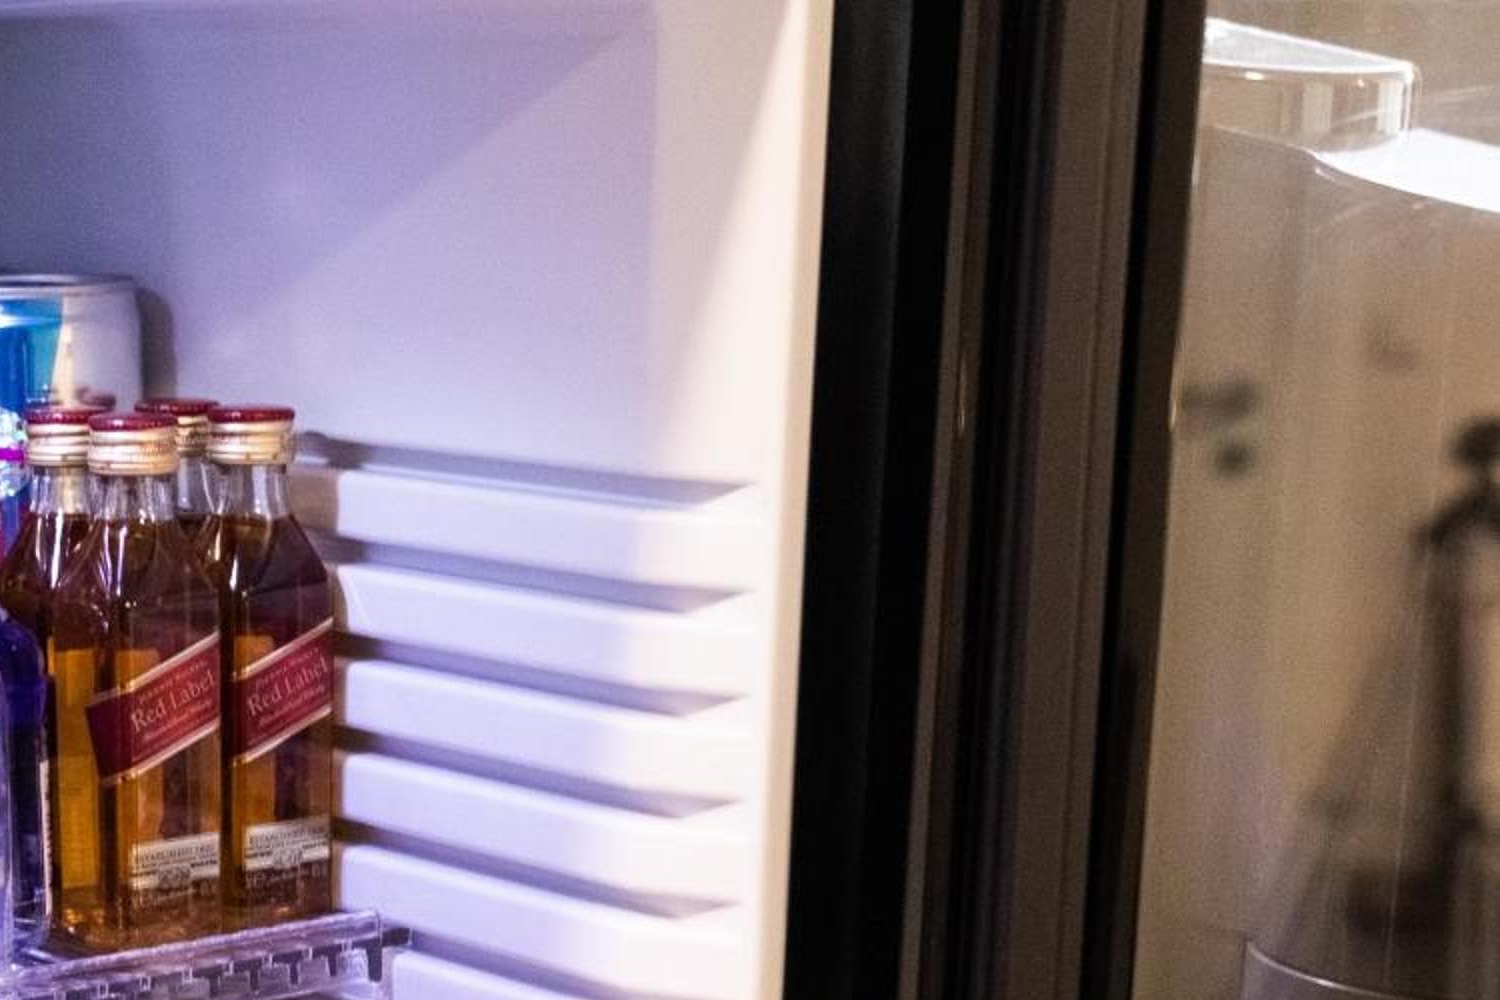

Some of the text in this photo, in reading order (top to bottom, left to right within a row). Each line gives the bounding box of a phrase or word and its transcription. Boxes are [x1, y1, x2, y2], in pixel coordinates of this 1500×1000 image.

[131, 702, 167, 732] Red
[169, 670, 216, 709] Label
[249, 683, 282, 716] Red
[285, 656, 328, 694] Label
